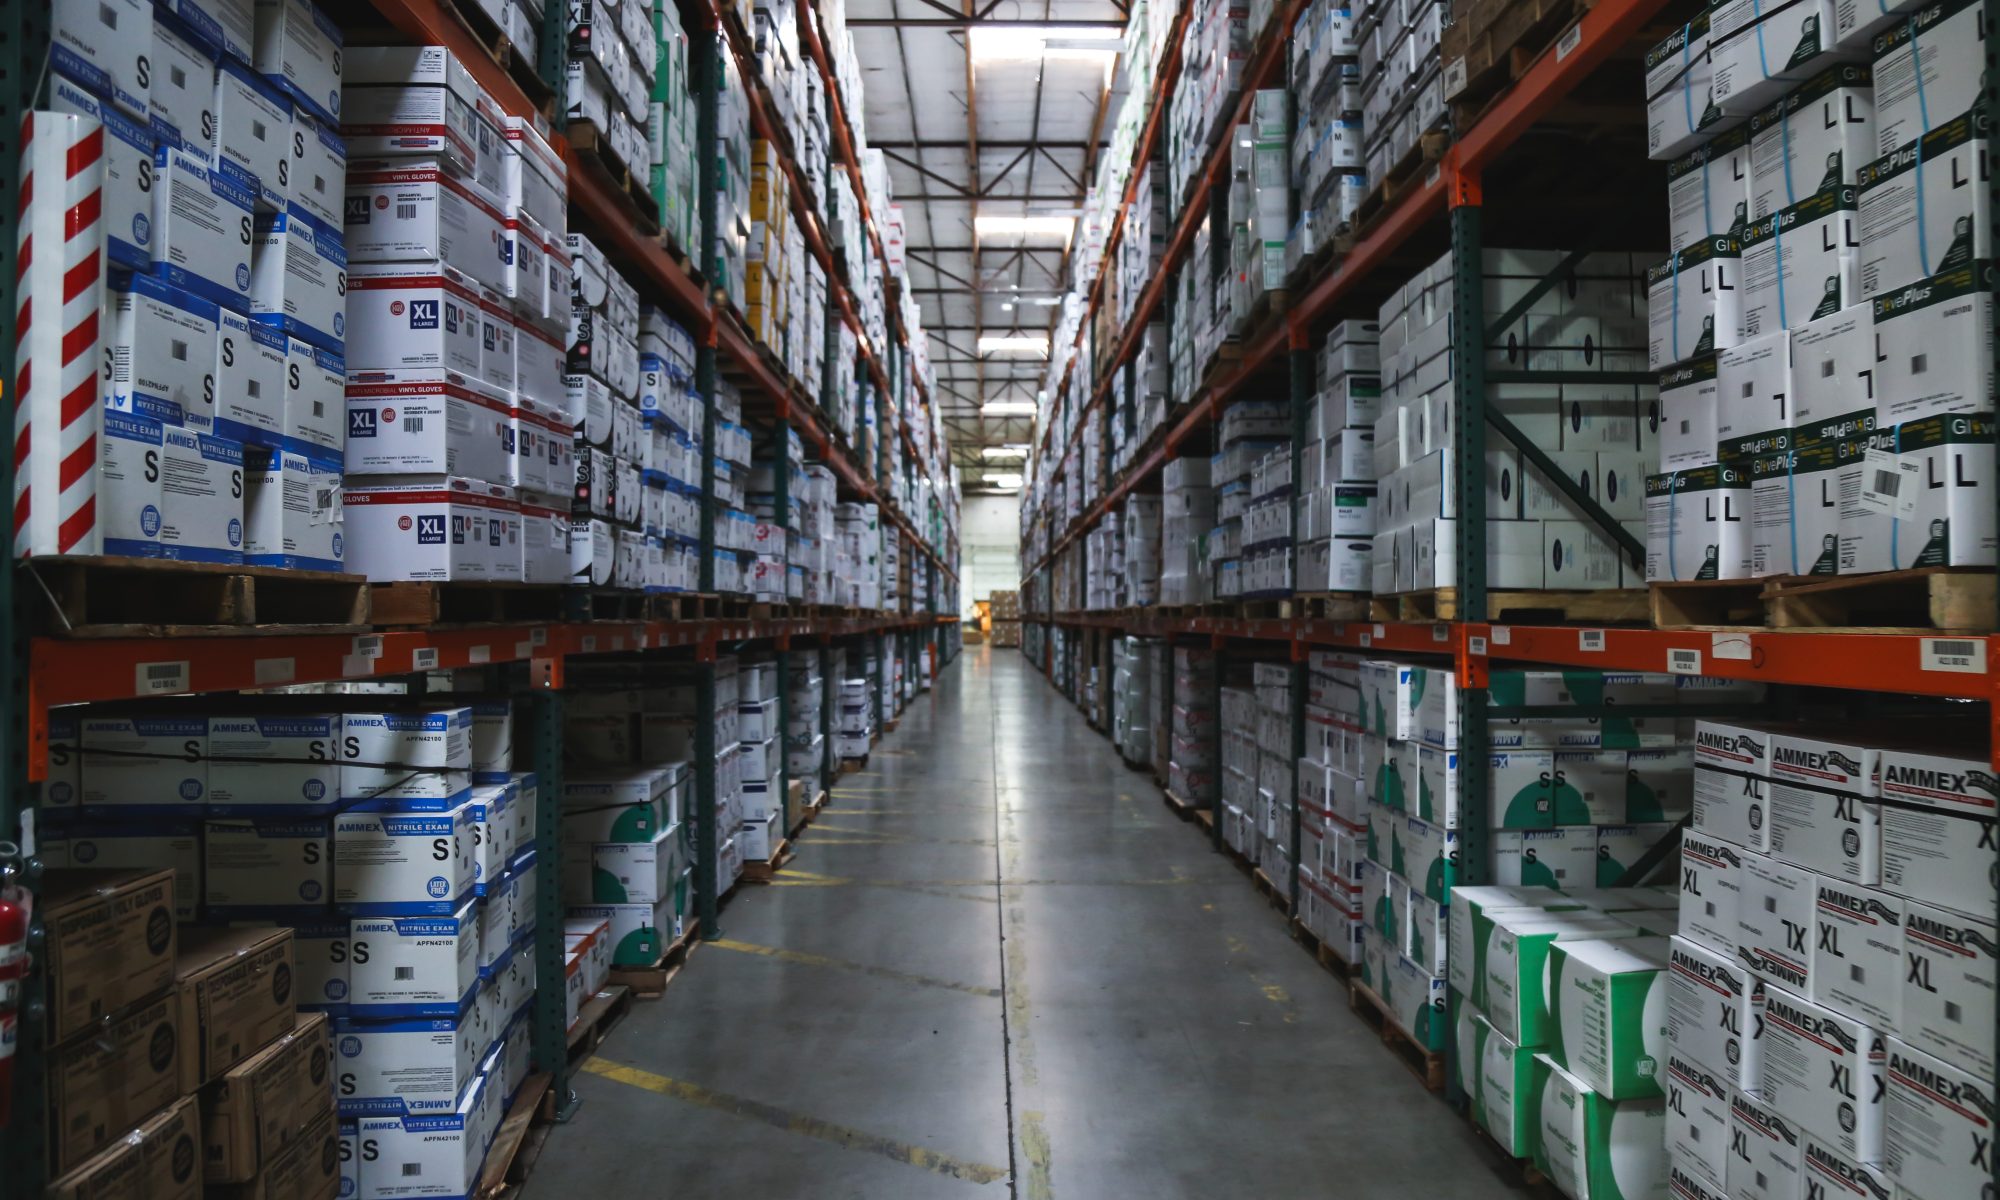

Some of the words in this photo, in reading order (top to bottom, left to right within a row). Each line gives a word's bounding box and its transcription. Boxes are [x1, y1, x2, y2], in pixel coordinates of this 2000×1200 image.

[1334, 22, 1341, 31] M
[1874, 4, 1942, 54] GlovePlus
[1647, 34, 1687, 68] GlovePlus
[137, 55, 150, 90] S
[57, 84, 99, 118] AMMEX
[104, 113, 136, 140] NITRILE
[113, 85, 147, 115] AMMEX
[1846, 96, 1865, 124] L
[202, 109, 213, 141] S
[1824, 102, 1837, 131] L
[1334, 133, 1342, 142] M
[138, 159, 151, 193] S
[175, 157, 207, 186] AMMEX
[212, 178, 239, 201] NITRILE
[279, 158, 288, 187] S
[1734, 157, 1745, 182] L
[1858, 146, 1918, 186] GlovePlus
[1952, 156, 1969, 190] L
[261, 188, 287, 207] AMMEX
[240, 216, 251, 245] S
[288, 222, 312, 245] AMMEX
[1306, 222, 1313, 230] M
[1743, 212, 1796, 243] GlovePlus
[1824, 224, 1837, 253] L
[1846, 218, 1860, 248] L
[1702, 269, 1712, 295] L
[1718, 266, 1735, 291] L
[413, 304, 437, 321] XL
[1874, 285, 1932, 317] GlovePlus
[223, 316, 248, 333] AMMEX
[251, 328, 272, 344] NITRILE
[222, 337, 233, 367] S
[291, 343, 313, 360] AMMEX
[1876, 332, 1888, 363] L
[203, 374, 213, 405] S
[289, 363, 300, 391] S
[646, 374, 656, 387] S
[156, 404, 181, 420] NITRILE
[185, 413, 211, 428] AMMEX
[352, 412, 376, 429] XL
[105, 418, 137, 435] NITRILE
[139, 426, 161, 439] EXAM
[1821, 415, 1876, 440] GlovePlus
[166, 433, 199, 452] AMMEX
[202, 443, 225, 457] NITRILE
[226, 448, 242, 461] EXAM
[1741, 435, 1788, 455] GlovePlus
[1838, 434, 1897, 459] GlovePlus
[145, 450, 159, 484] S
[284, 458, 308, 473] AMMEX
[1752, 455, 1799, 476] GlovePlus
[1928, 456, 1945, 490] L
[1956, 454, 1979, 488] L
[232, 470, 242, 499] S
[1646, 476, 1687, 494] GlovePlus
[1822, 479, 1836, 508] L
[1706, 496, 1717, 523] L
[1724, 496, 1741, 523] L
[420, 518, 444, 535] XL
[86, 724, 139, 733] AMMEX
[212, 724, 256, 733] AMMEX
[264, 725, 299, 734] NITRILE
[302, 725, 327, 733] EXAM
[347, 719, 387, 727] AMMEX
[389, 720, 419, 728] NITRILE
[309, 742, 326, 763] S
[344, 736, 361, 759] S
[1696, 731, 1739, 754] AMMEX
[1774, 747, 1829, 772] AMMEX
[1540, 771, 1551, 788] S
[1554, 770, 1566, 787] S
[1884, 764, 1968, 795] AMMEX
[1834, 796, 1861, 825] XL
[338, 824, 383, 833] AMMEX
[432, 838, 449, 861] S
[1526, 848, 1537, 865] S
[1598, 844, 1610, 861] S
[1683, 838, 1721, 862] AMMEX
[430, 880, 447, 889] LATEX
[430, 887, 446, 895] FREE
[1682, 867, 1702, 898] XL
[1818, 886, 1870, 916] AMMEX
[356, 924, 395, 933] AMMEX
[1780, 919, 1808, 955] XL
[1818, 921, 1845, 959] XL
[1906, 914, 1966, 948] AMMEX
[330, 940, 346, 963] S
[353, 942, 370, 964] S
[1671, 950, 1718, 984] AMMEX
[1761, 958, 1807, 989] AMMEX
[1908, 952, 1938, 995] XL
[1434, 998, 1446, 1014] S
[1766, 998, 1825, 1039] AMMEX
[1720, 1002, 1742, 1038] XL
[340, 1073, 357, 1096] S
[1668, 1056, 1706, 1089] AMMEX
[1830, 1060, 1858, 1102] XL
[1888, 1052, 1964, 1104] AMMEX
[367, 1102, 402, 1111] NITRILE
[410, 1100, 452, 1109] AMMEX
[1668, 1084, 1687, 1119] XL
[1731, 1090, 1774, 1131] AMMEX
[362, 1122, 401, 1131] AMMEX
[208, 1144, 223, 1163] M
[363, 1139, 379, 1162] S
[1732, 1126, 1752, 1164] XL
[1806, 1142, 1858, 1185] AMMEX
